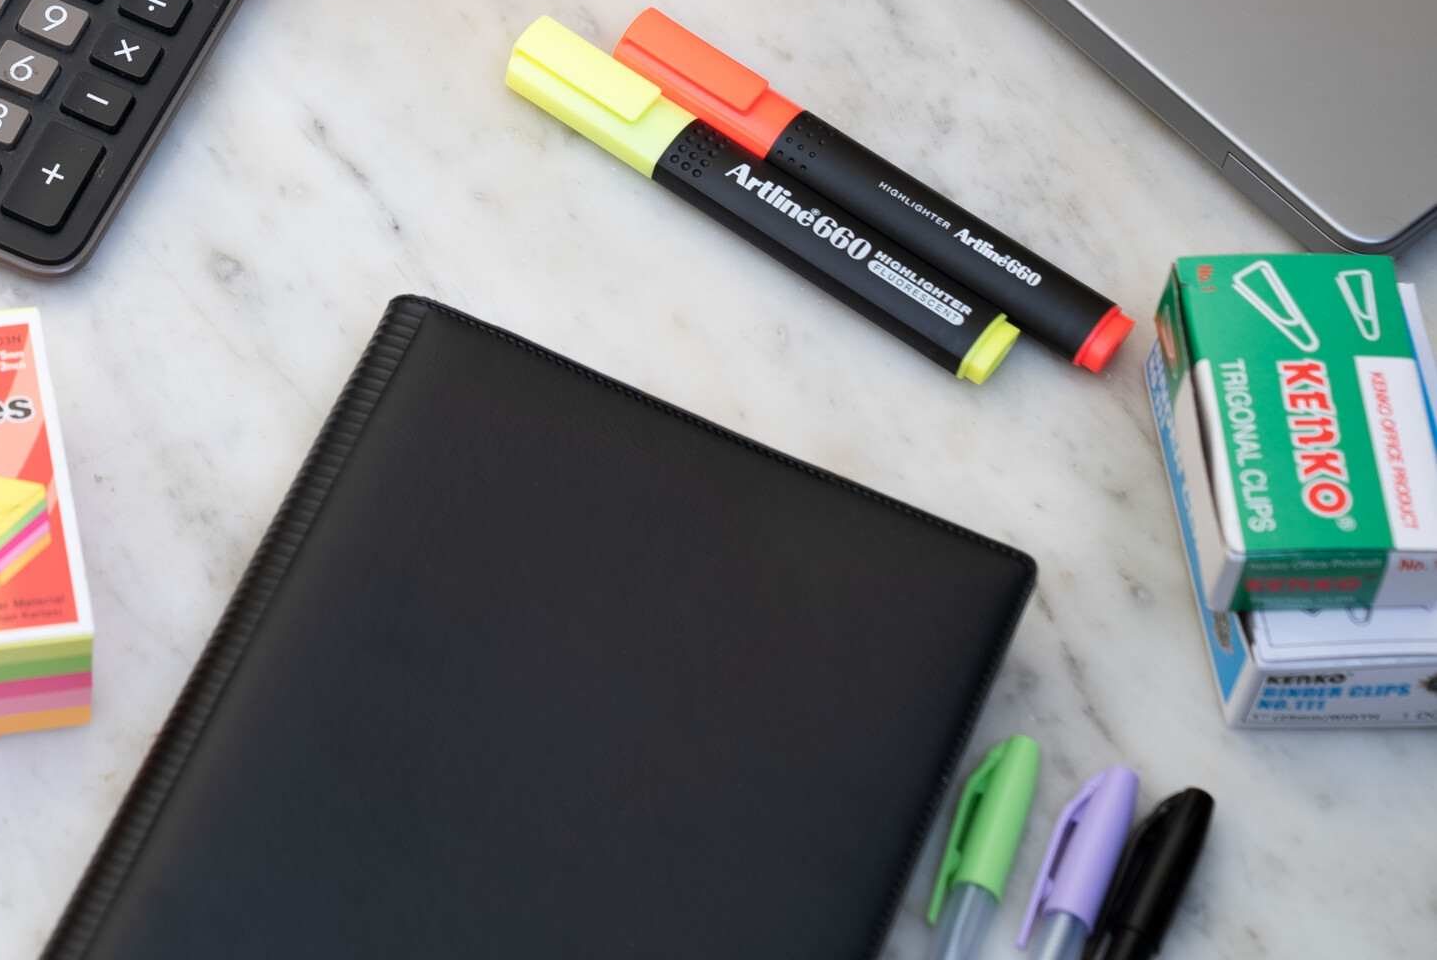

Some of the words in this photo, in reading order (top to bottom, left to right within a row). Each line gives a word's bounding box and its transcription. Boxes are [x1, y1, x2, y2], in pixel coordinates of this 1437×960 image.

[44, 5, 68, 32] 9
[9, 55, 35, 81] 6
[878, 181, 951, 230] HIGHLIGHTER
[873, 264, 960, 322] FLUORESCENT
[874, 250, 973, 316] HIGHLIGHTER
[1219, 357, 1263, 467] TRIGONAL
[1380, 418, 1405, 464] OFFICE
[1239, 468, 1277, 533] CLIPS
[1392, 465, 1420, 530] PRODUCT
[1263, 686, 1342, 698] BINDER
[1349, 684, 1411, 697] CLIPS
